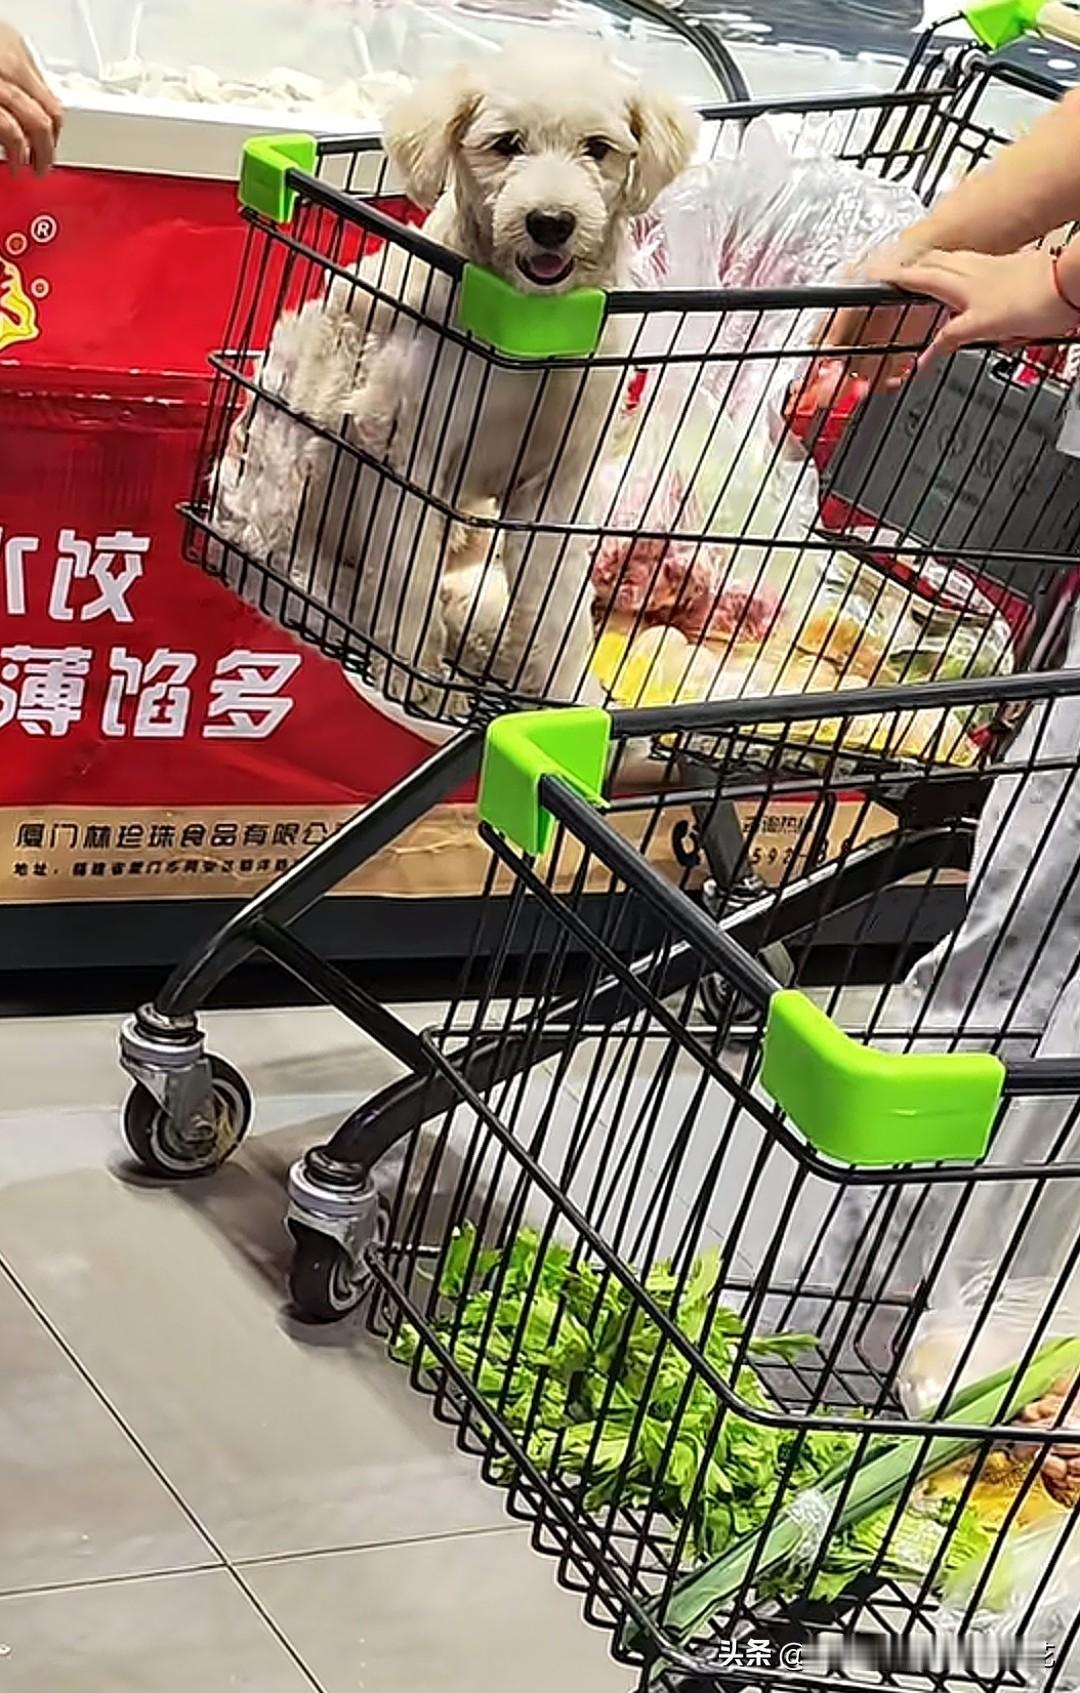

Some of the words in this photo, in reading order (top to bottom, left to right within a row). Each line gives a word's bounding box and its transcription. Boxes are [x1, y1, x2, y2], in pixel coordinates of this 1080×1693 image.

[16, 822, 346, 849] 厦门林珍珠食品有限公
